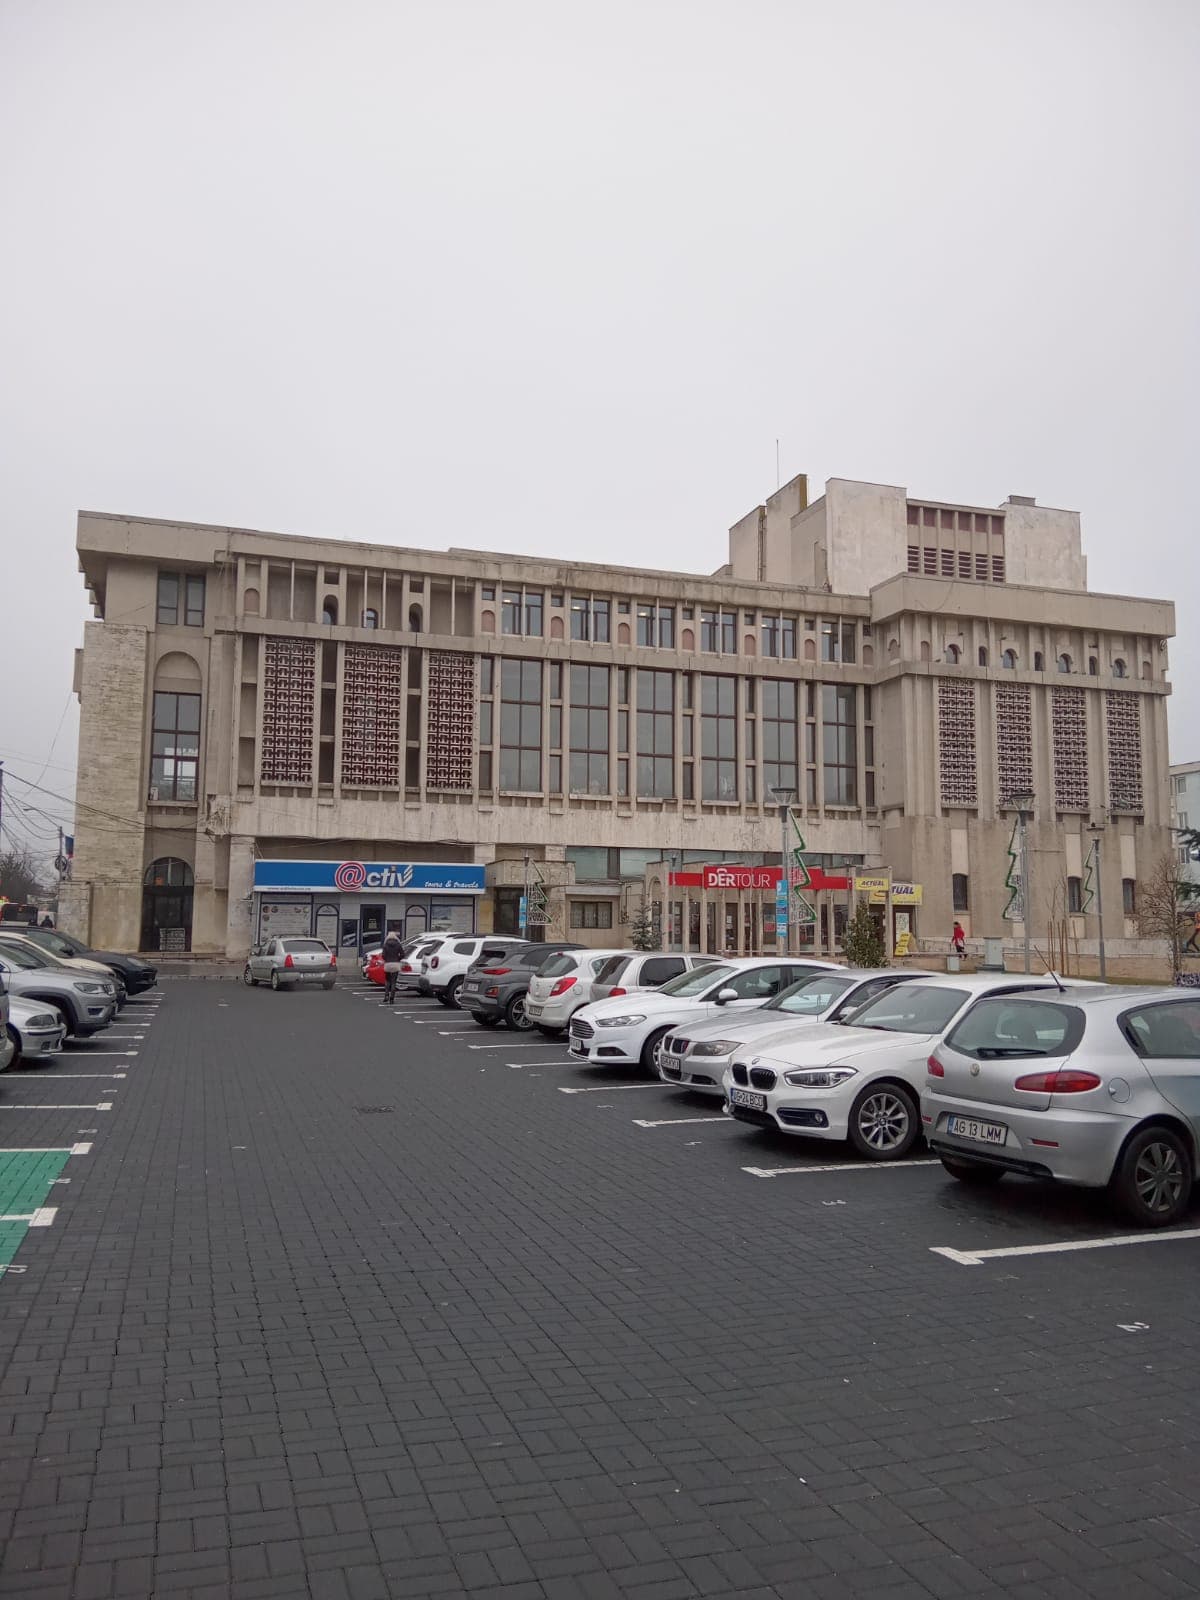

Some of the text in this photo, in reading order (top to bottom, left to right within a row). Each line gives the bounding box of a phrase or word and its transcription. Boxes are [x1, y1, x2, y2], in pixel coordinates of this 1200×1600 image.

[445, 880, 452, 888] &
[708, 869, 770, 887] DERTOUR
[861, 879, 884, 887] ACTUAL
[953, 1119, 1002, 1141] AG 13 LMM
